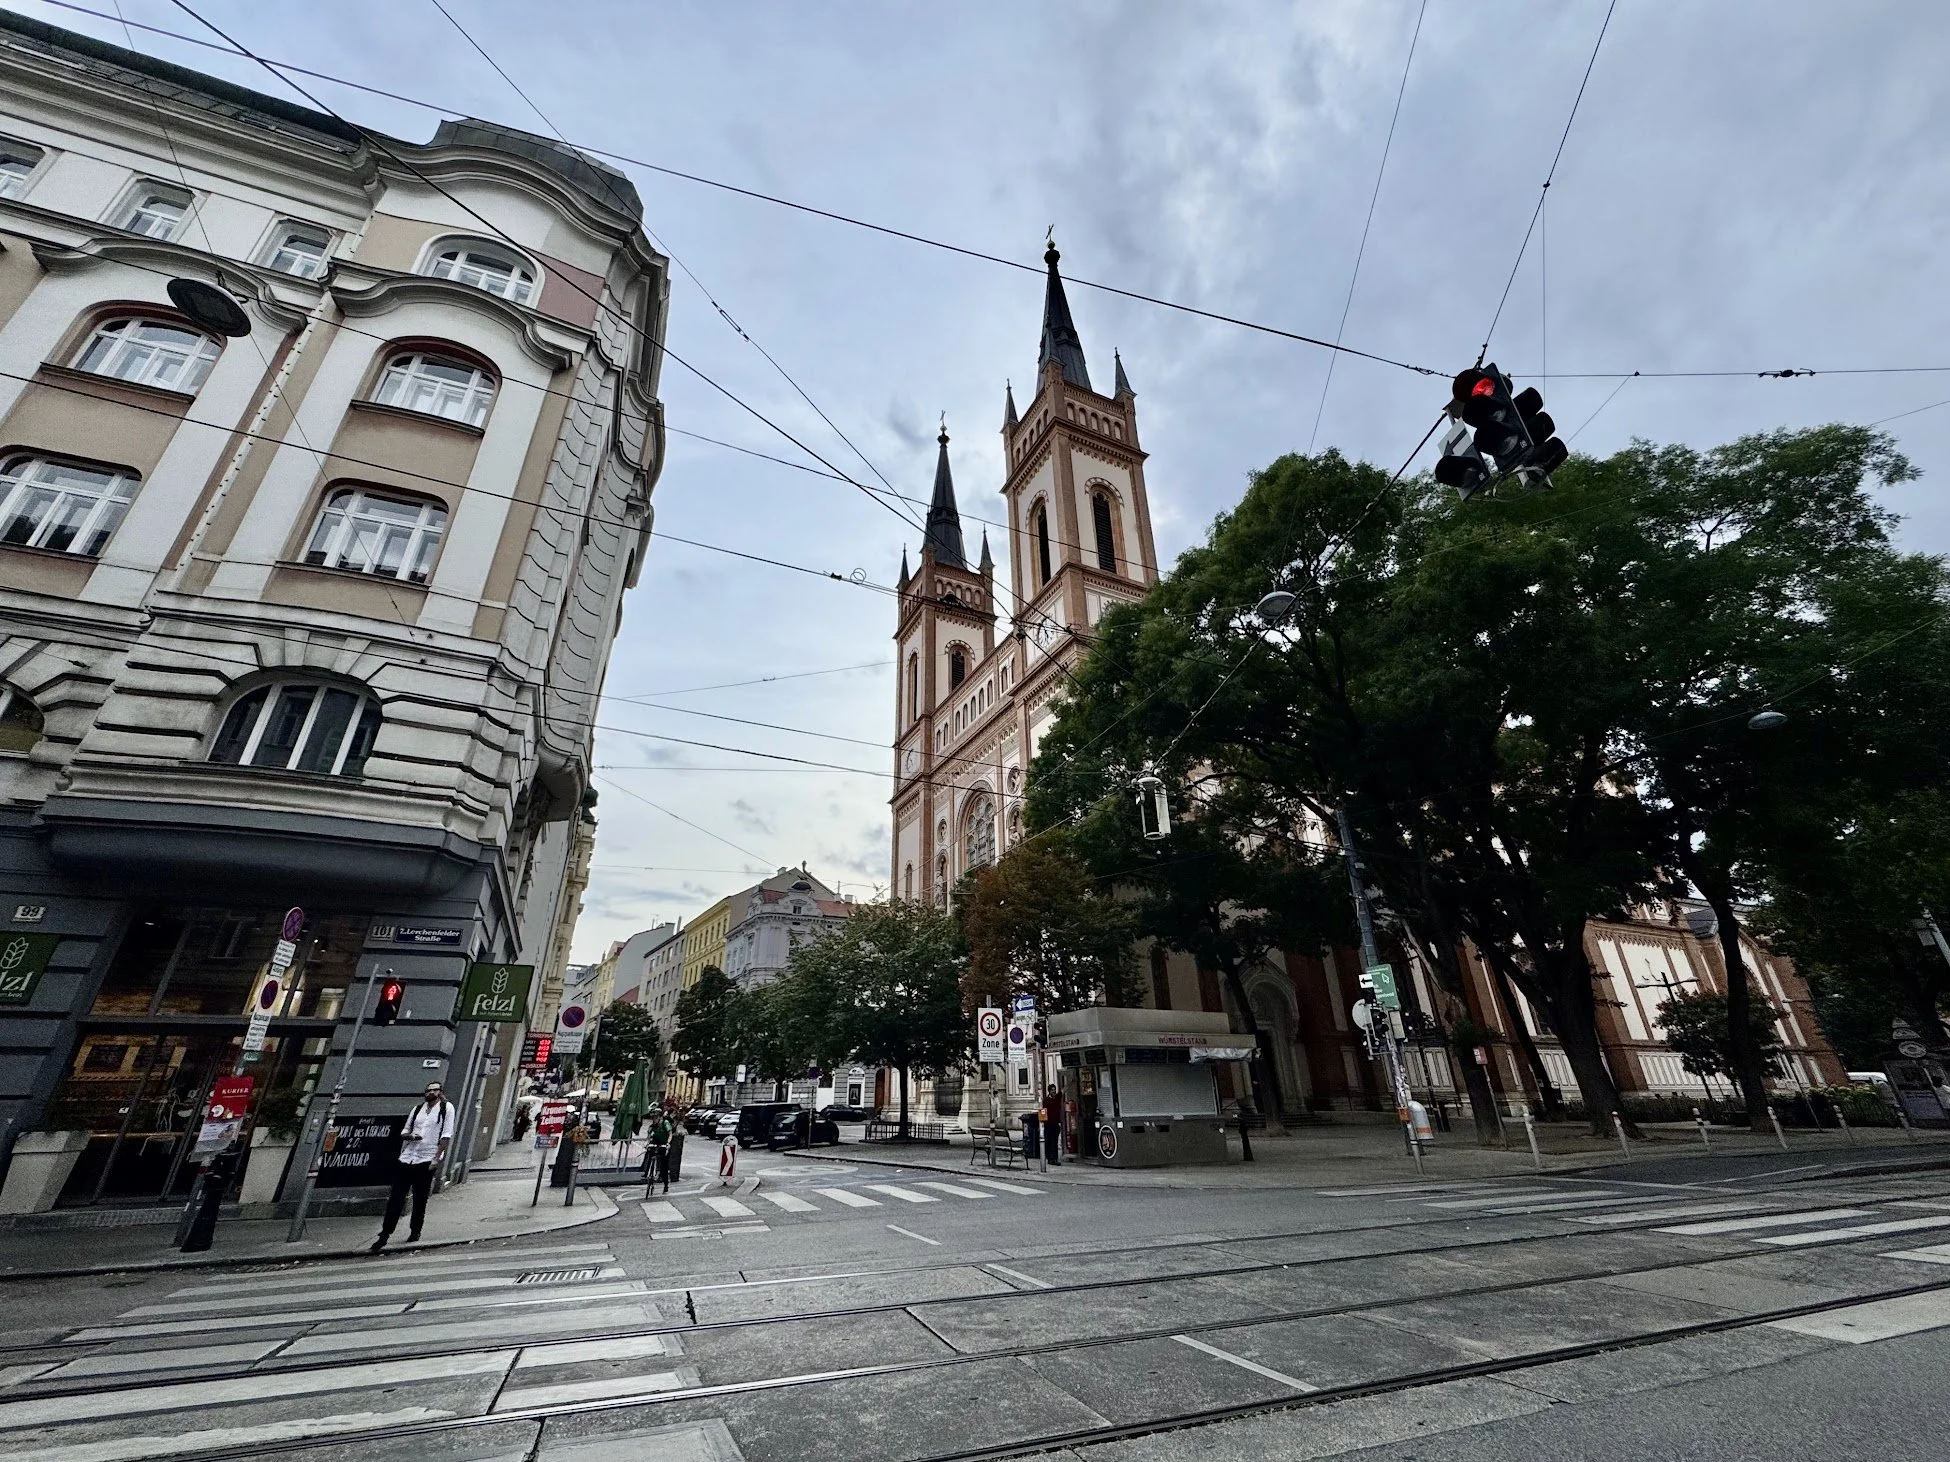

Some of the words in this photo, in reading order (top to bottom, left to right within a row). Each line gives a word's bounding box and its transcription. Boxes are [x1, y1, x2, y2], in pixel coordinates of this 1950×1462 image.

[20, 906, 40, 917] 99
[374, 926, 394, 937] 101
[472, 993, 516, 1016] felzl
[986, 1018, 996, 1030] 30
[982, 1037, 1000, 1048] Zone
[221, 1087, 249, 1095] KURIER
[541, 1105, 568, 1116] Kronen
[540, 1115, 566, 1126] Zeitung
